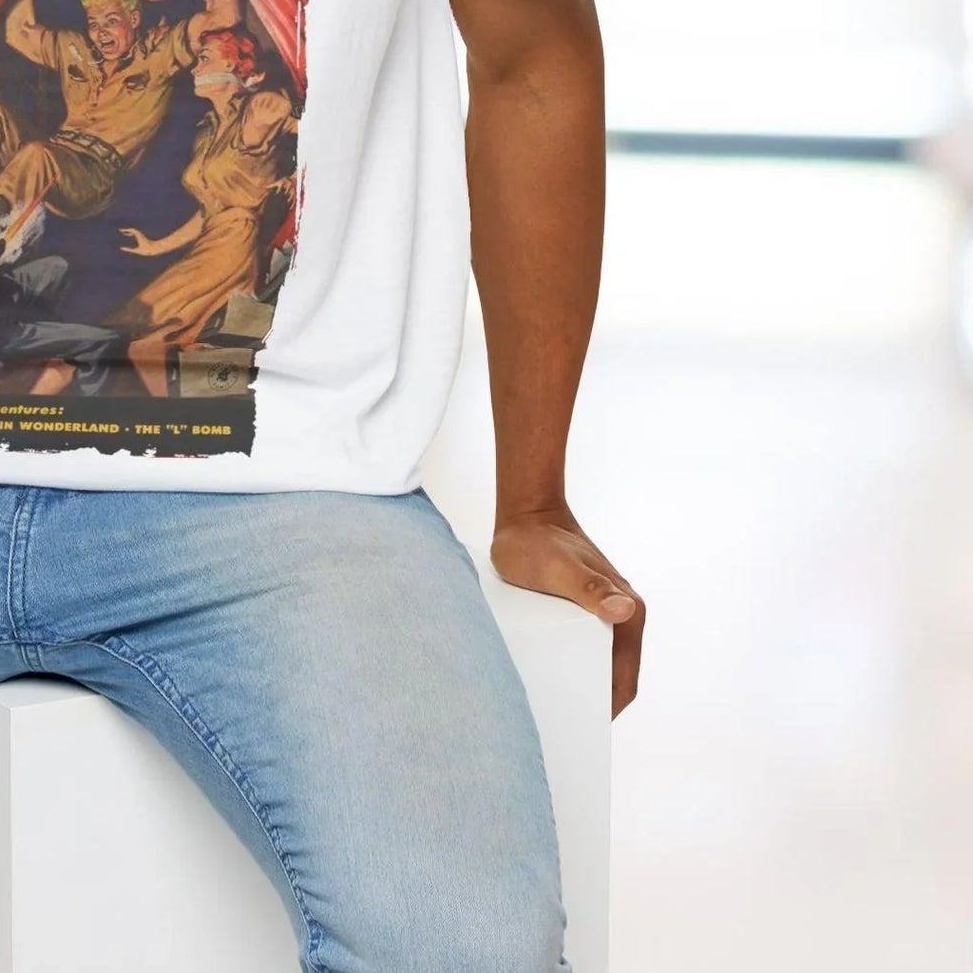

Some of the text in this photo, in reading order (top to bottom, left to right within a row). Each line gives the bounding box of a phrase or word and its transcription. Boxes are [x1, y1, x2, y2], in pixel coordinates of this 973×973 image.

[0, 421, 13, 430] IN
[19, 421, 120, 433] WONDERLAND
[135, 424, 161, 435] THE
[192, 425, 232, 435] BOMB
